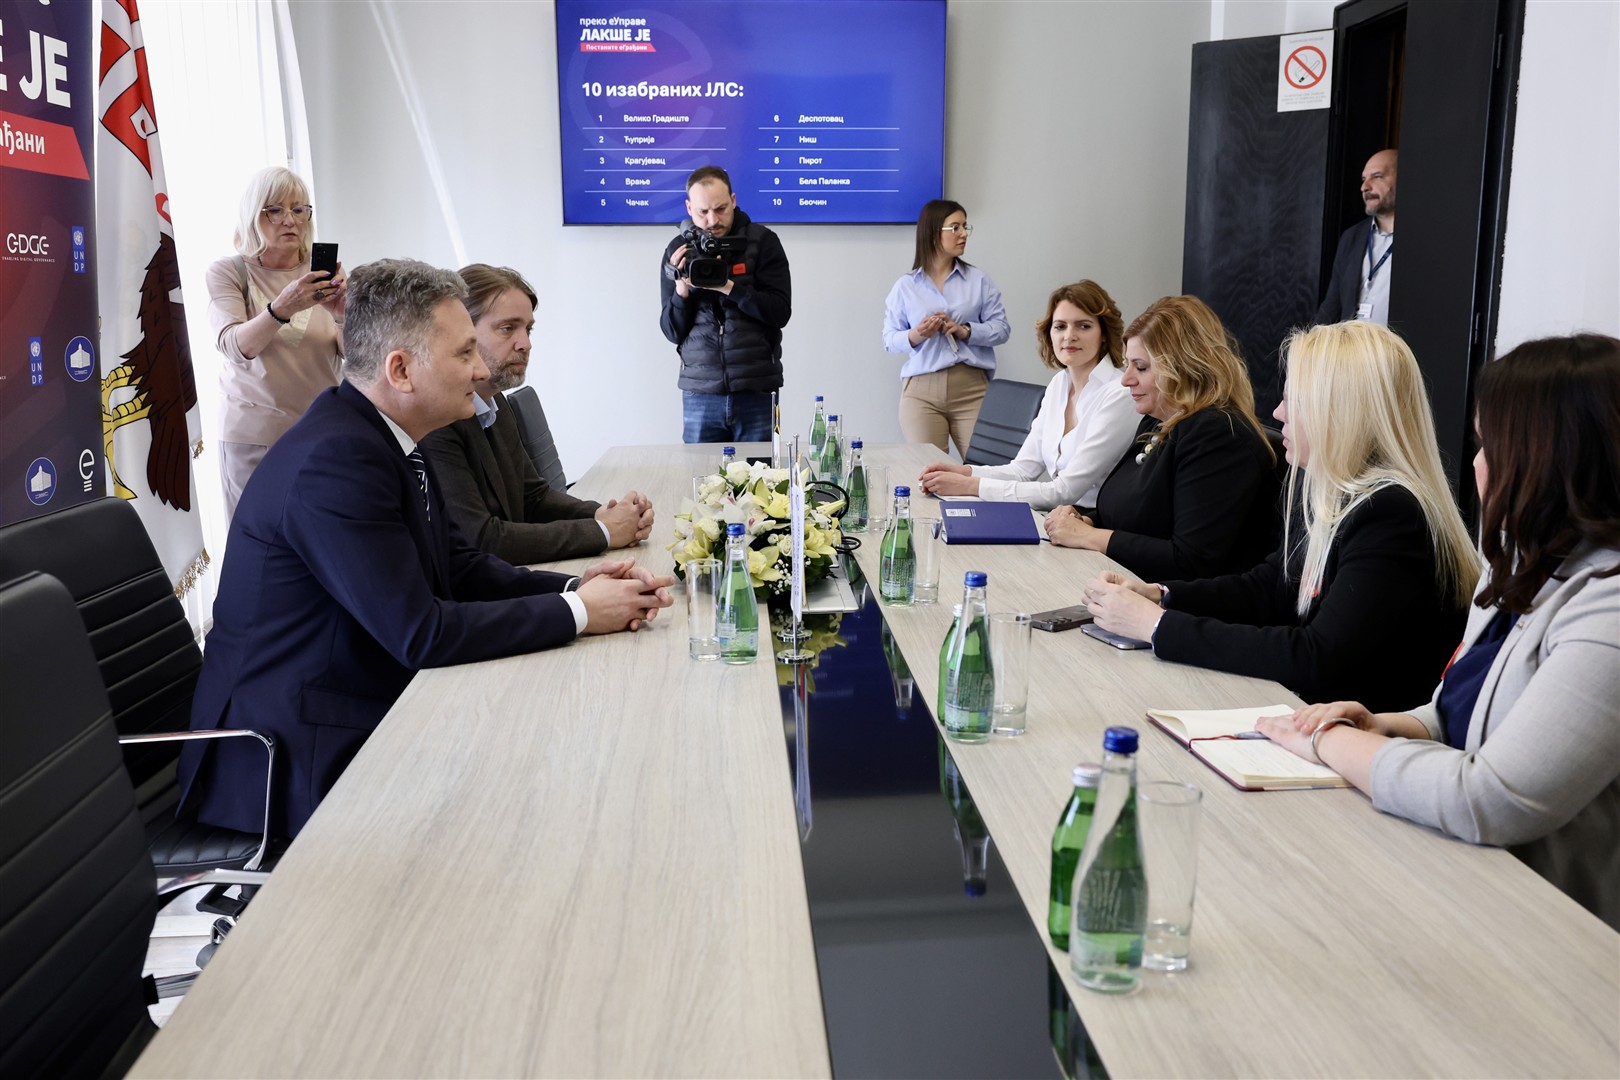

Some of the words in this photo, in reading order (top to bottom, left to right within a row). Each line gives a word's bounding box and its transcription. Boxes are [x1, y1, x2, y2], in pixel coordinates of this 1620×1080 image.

[579, 18, 608, 27] преко
[608, 16, 647, 27] еУправе
[579, 28, 632, 41] ЛАКШЕ
[634, 28, 651, 41] ЈЕ
[19, 30, 71, 109] ЈЕ
[582, 82, 602, 97] 10
[605, 81, 702, 100] изабраних
[704, 82, 744, 97] ЈЛС:
[598, 114, 603, 122] 1
[623, 114, 651, 122] Велико
[652, 114, 690, 124] Градиште
[773, 114, 780, 122] 6
[798, 114, 845, 124] Деспотовац
[598, 135, 604, 143] 2
[623, 135, 655, 144] Ћуприја
[774, 135, 780, 143] 7
[798, 135, 817, 143] Ниш
[599, 156, 605, 164] 3
[624, 156, 666, 166] Крагујевац
[773, 156, 780, 164] 8
[798, 156, 823, 166] Пирот
[600, 177, 606, 185] 4
[625, 177, 651, 186] Врање
[774, 177, 780, 185] 9
[798, 177, 818, 185] Бела
[818, 177, 851, 185] Паланка
[600, 198, 606, 206] 5
[625, 198, 649, 206] Чачак
[772, 198, 782, 206] 10
[798, 198, 827, 206] Беочин
